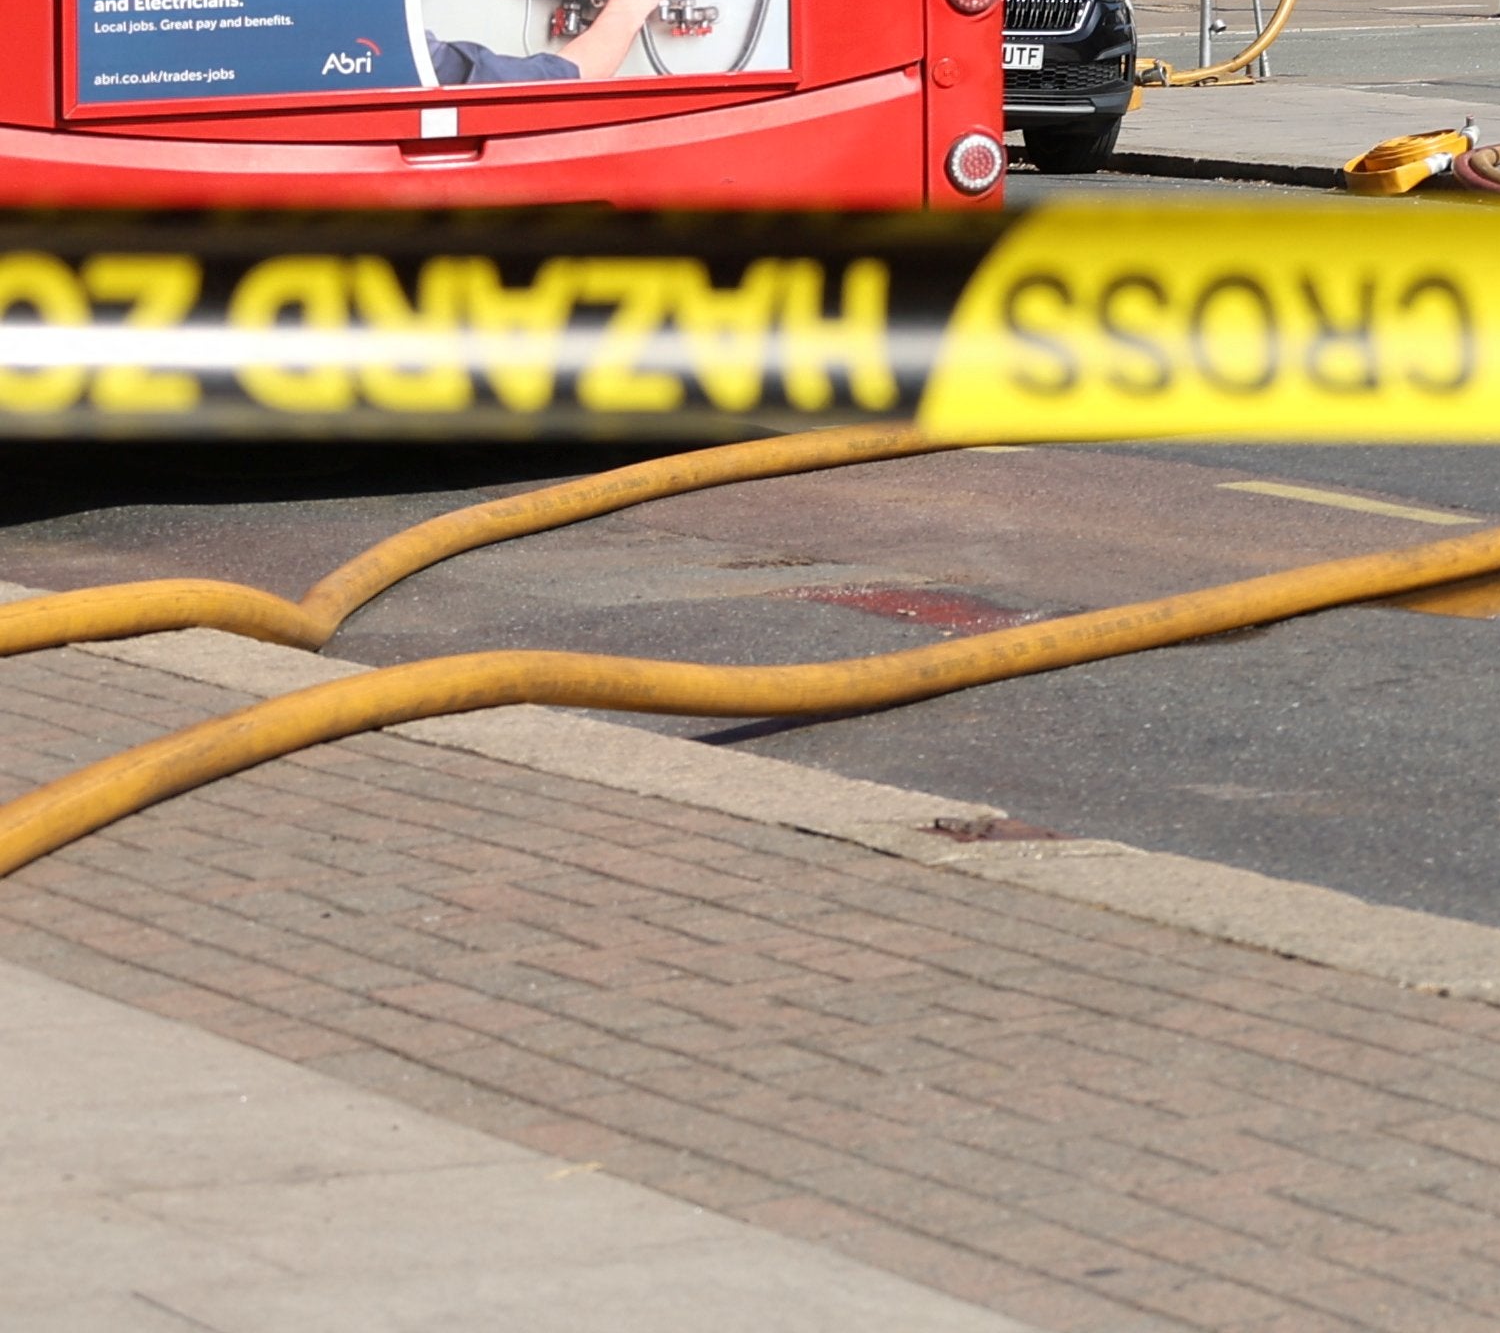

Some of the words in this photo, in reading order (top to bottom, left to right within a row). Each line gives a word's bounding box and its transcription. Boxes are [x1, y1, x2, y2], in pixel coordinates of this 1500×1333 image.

[94, 20, 127, 33] Local
[129, 19, 157, 34] jobs.
[160, 18, 193, 31] Great
[196, 18, 217, 31] pay
[219, 16, 242, 28] and
[244, 15, 294, 27] benefits.
[322, 51, 373, 75] Abri
[1003, 47, 1040, 65] UTF
[94, 67, 235, 85] abri.co.uk/trades-jobs
[228, 253, 899, 413] HAZARD
[1001, 268, 1477, 399] CROSS
